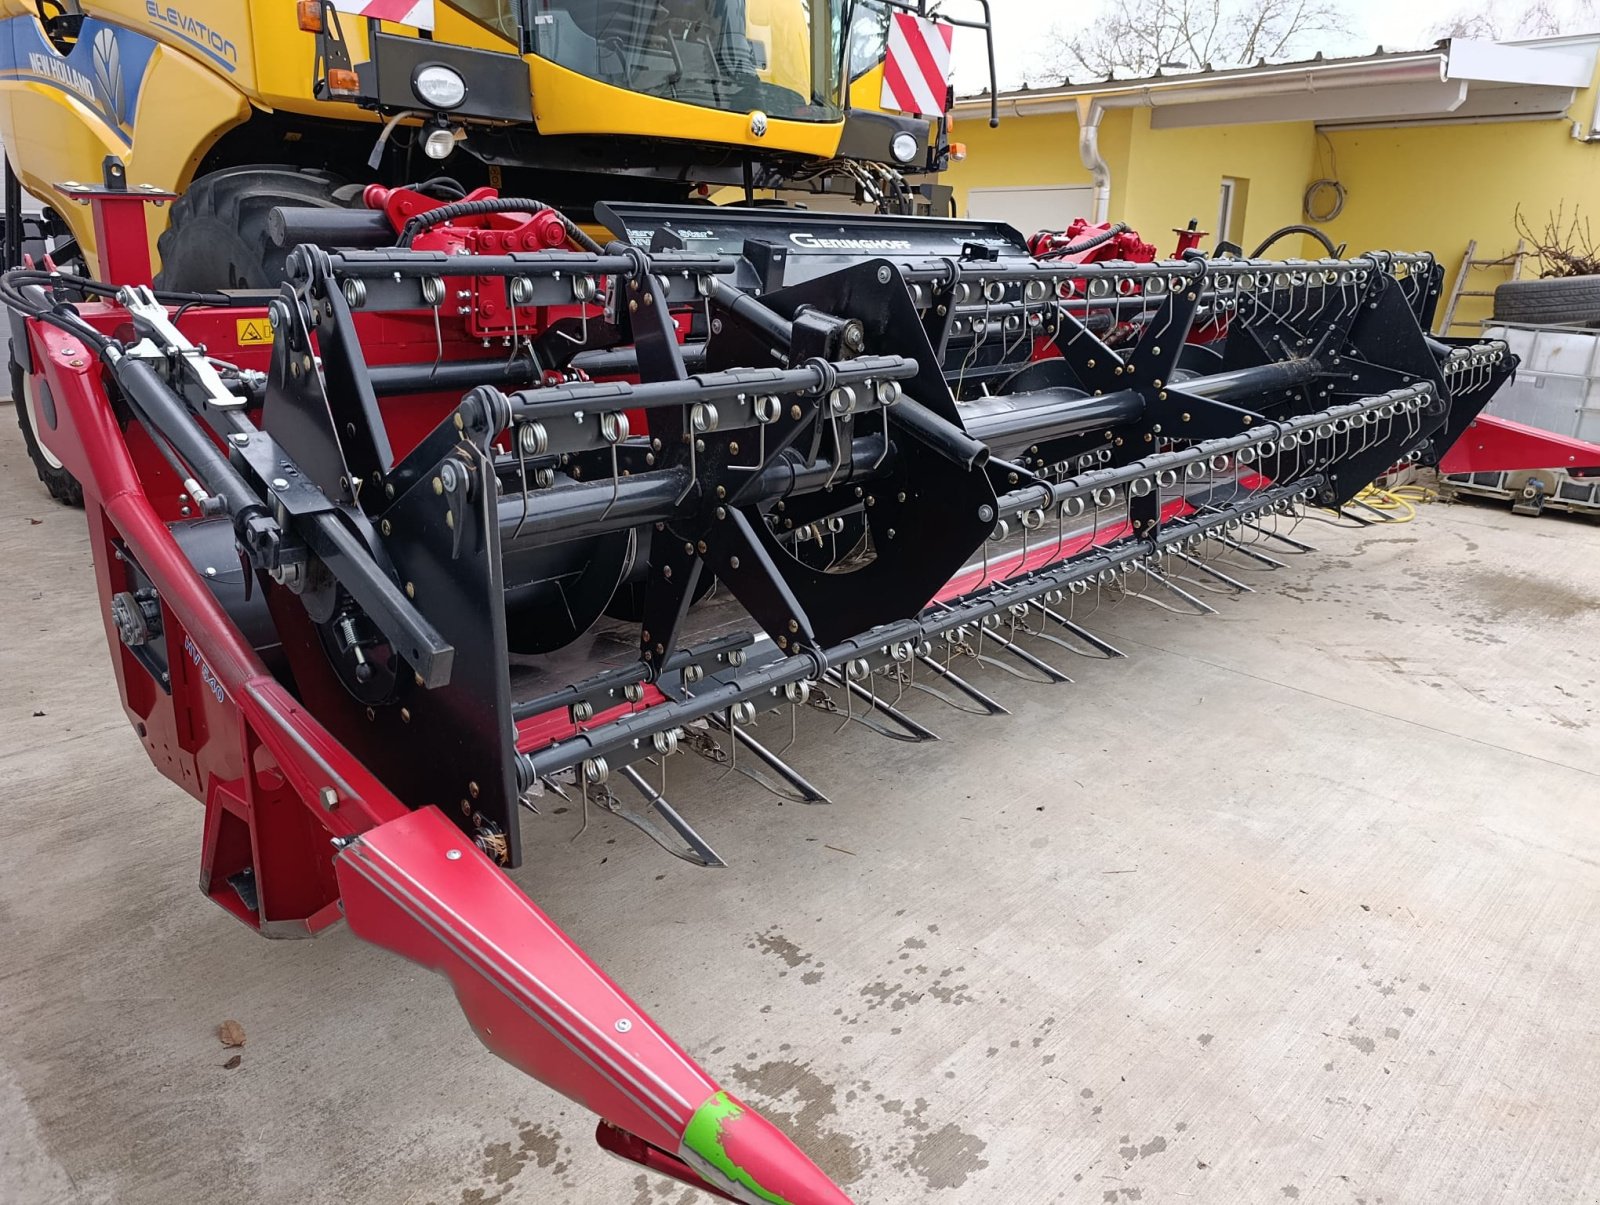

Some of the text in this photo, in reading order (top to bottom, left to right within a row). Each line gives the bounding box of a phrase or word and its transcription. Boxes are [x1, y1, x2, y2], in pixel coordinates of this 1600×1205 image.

[146, 0, 237, 62] ELEVATION
[28, 52, 96, 102] NEW HOLLAND
